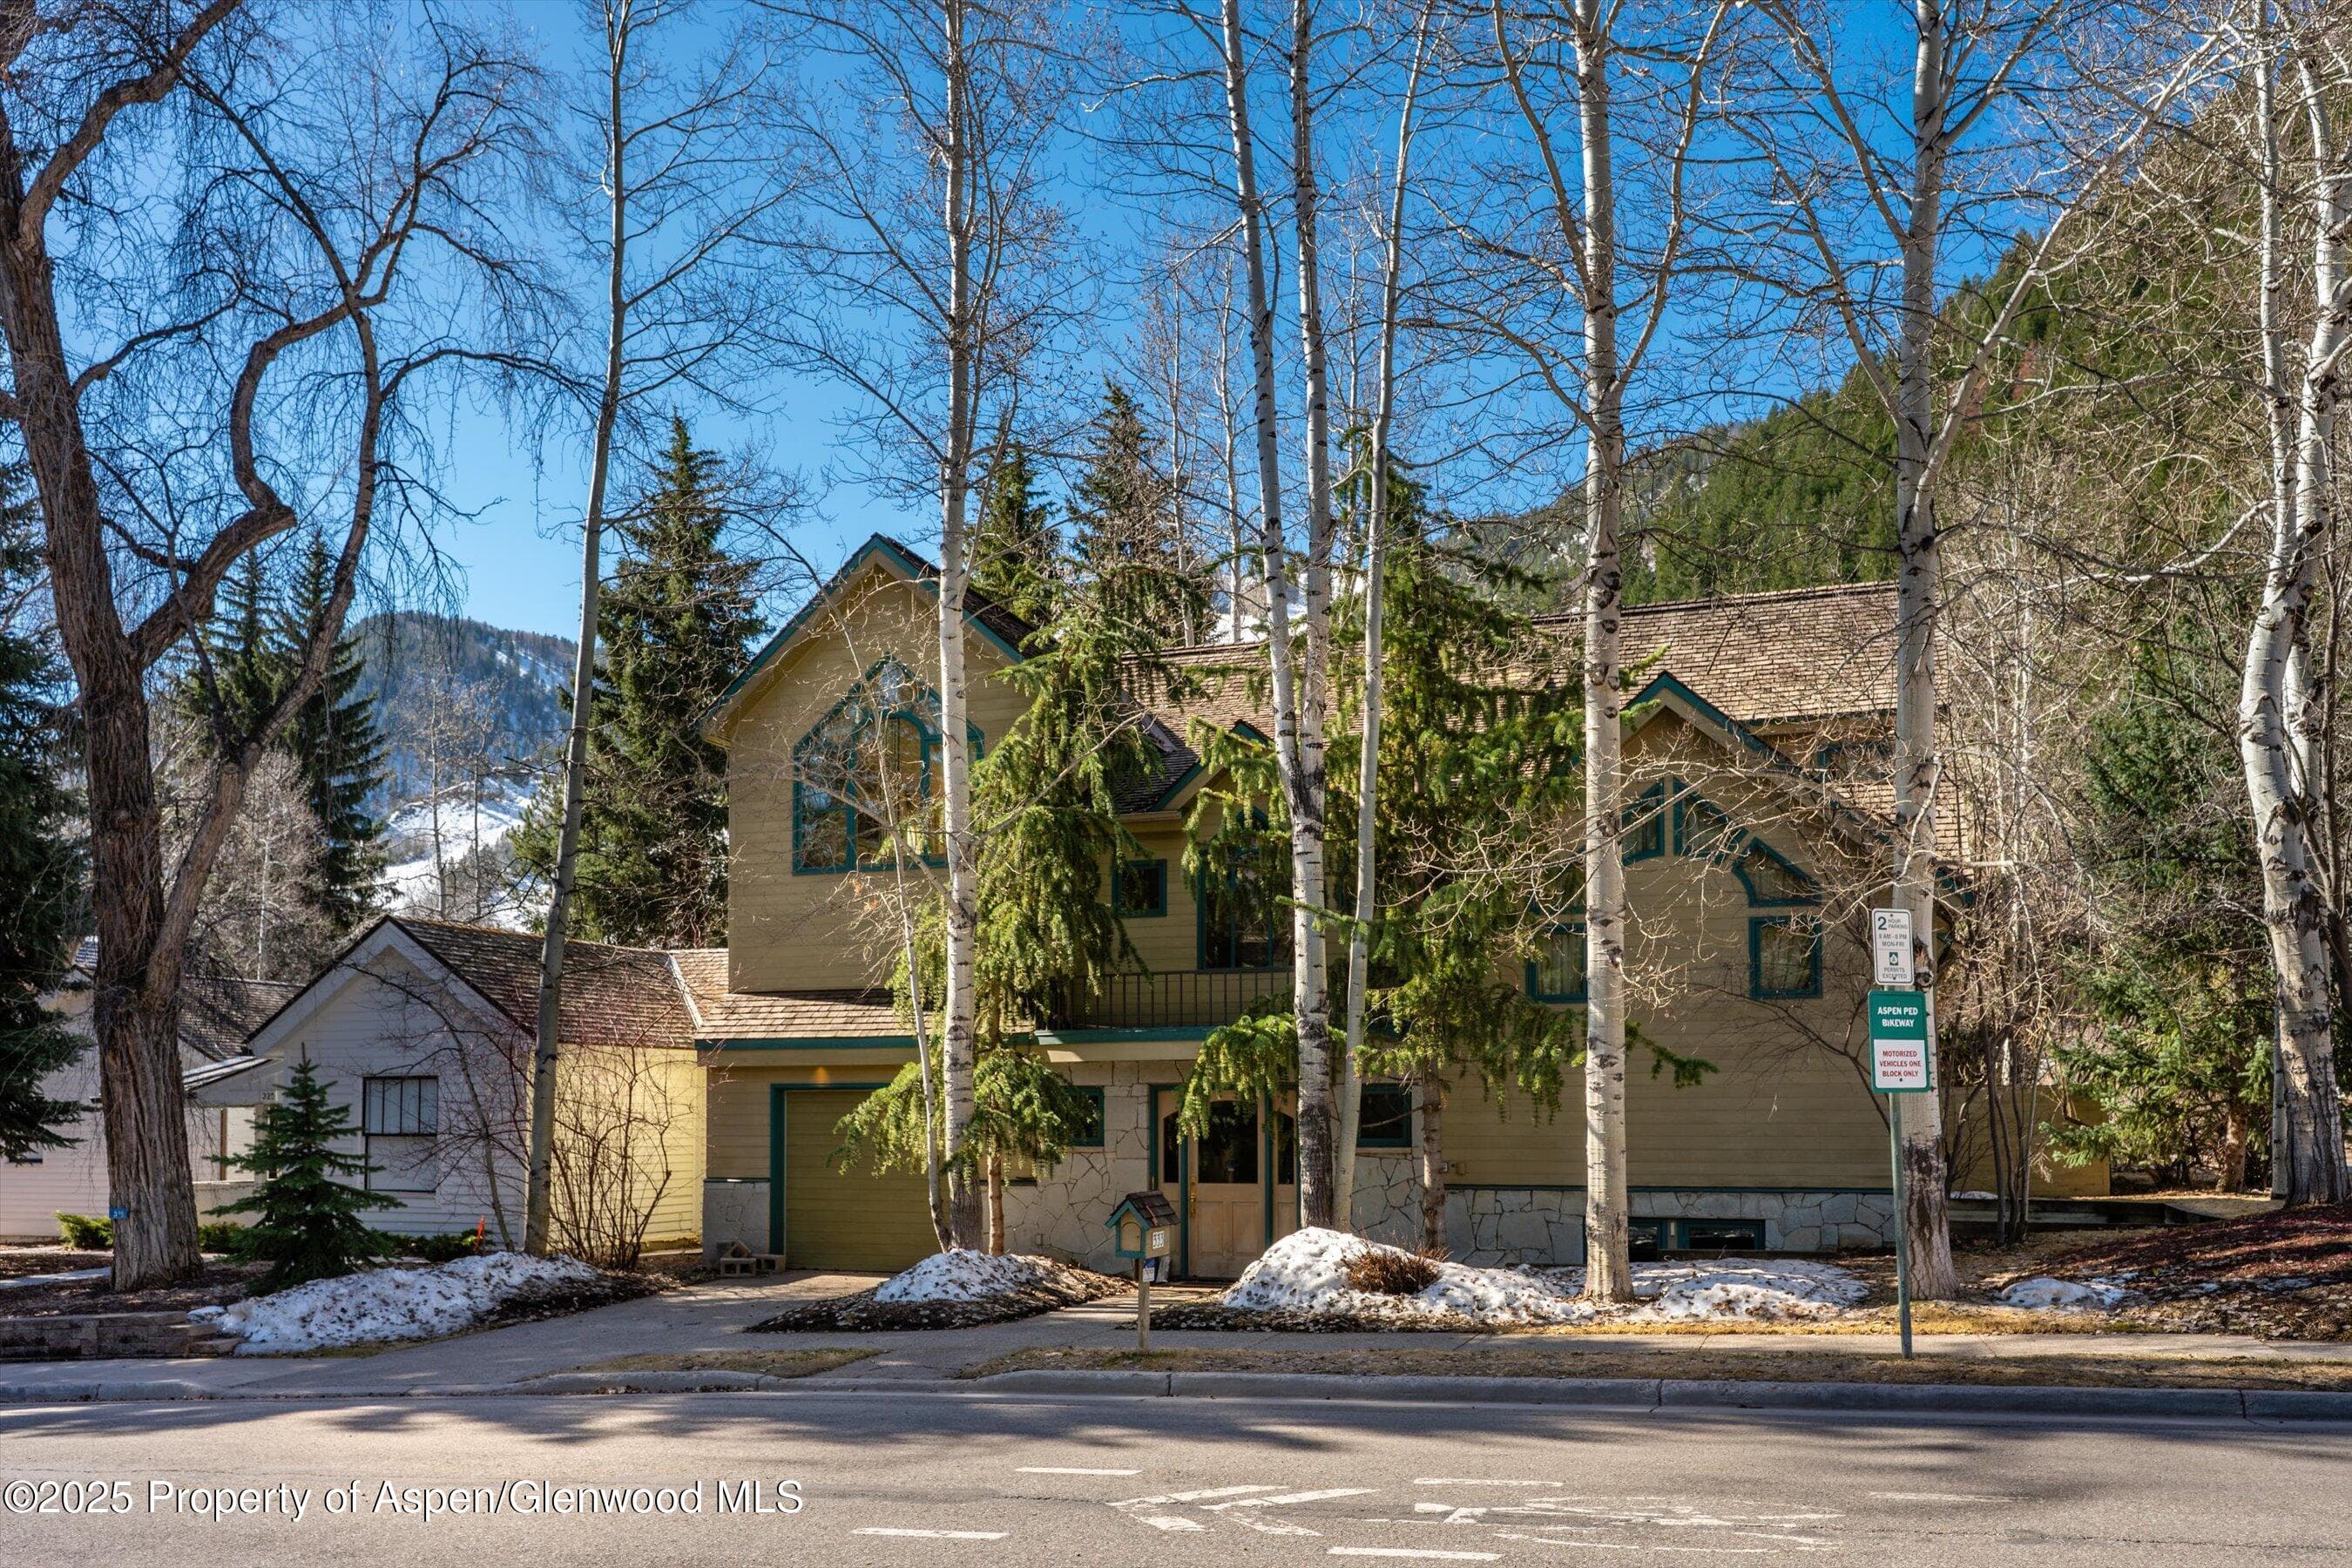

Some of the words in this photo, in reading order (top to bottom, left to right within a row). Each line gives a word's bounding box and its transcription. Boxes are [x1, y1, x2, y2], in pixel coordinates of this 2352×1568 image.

[1877, 916, 1888, 930] 2
[1877, 1006, 1903, 1015] ASPEN
[1903, 1007, 1919, 1016] PED
